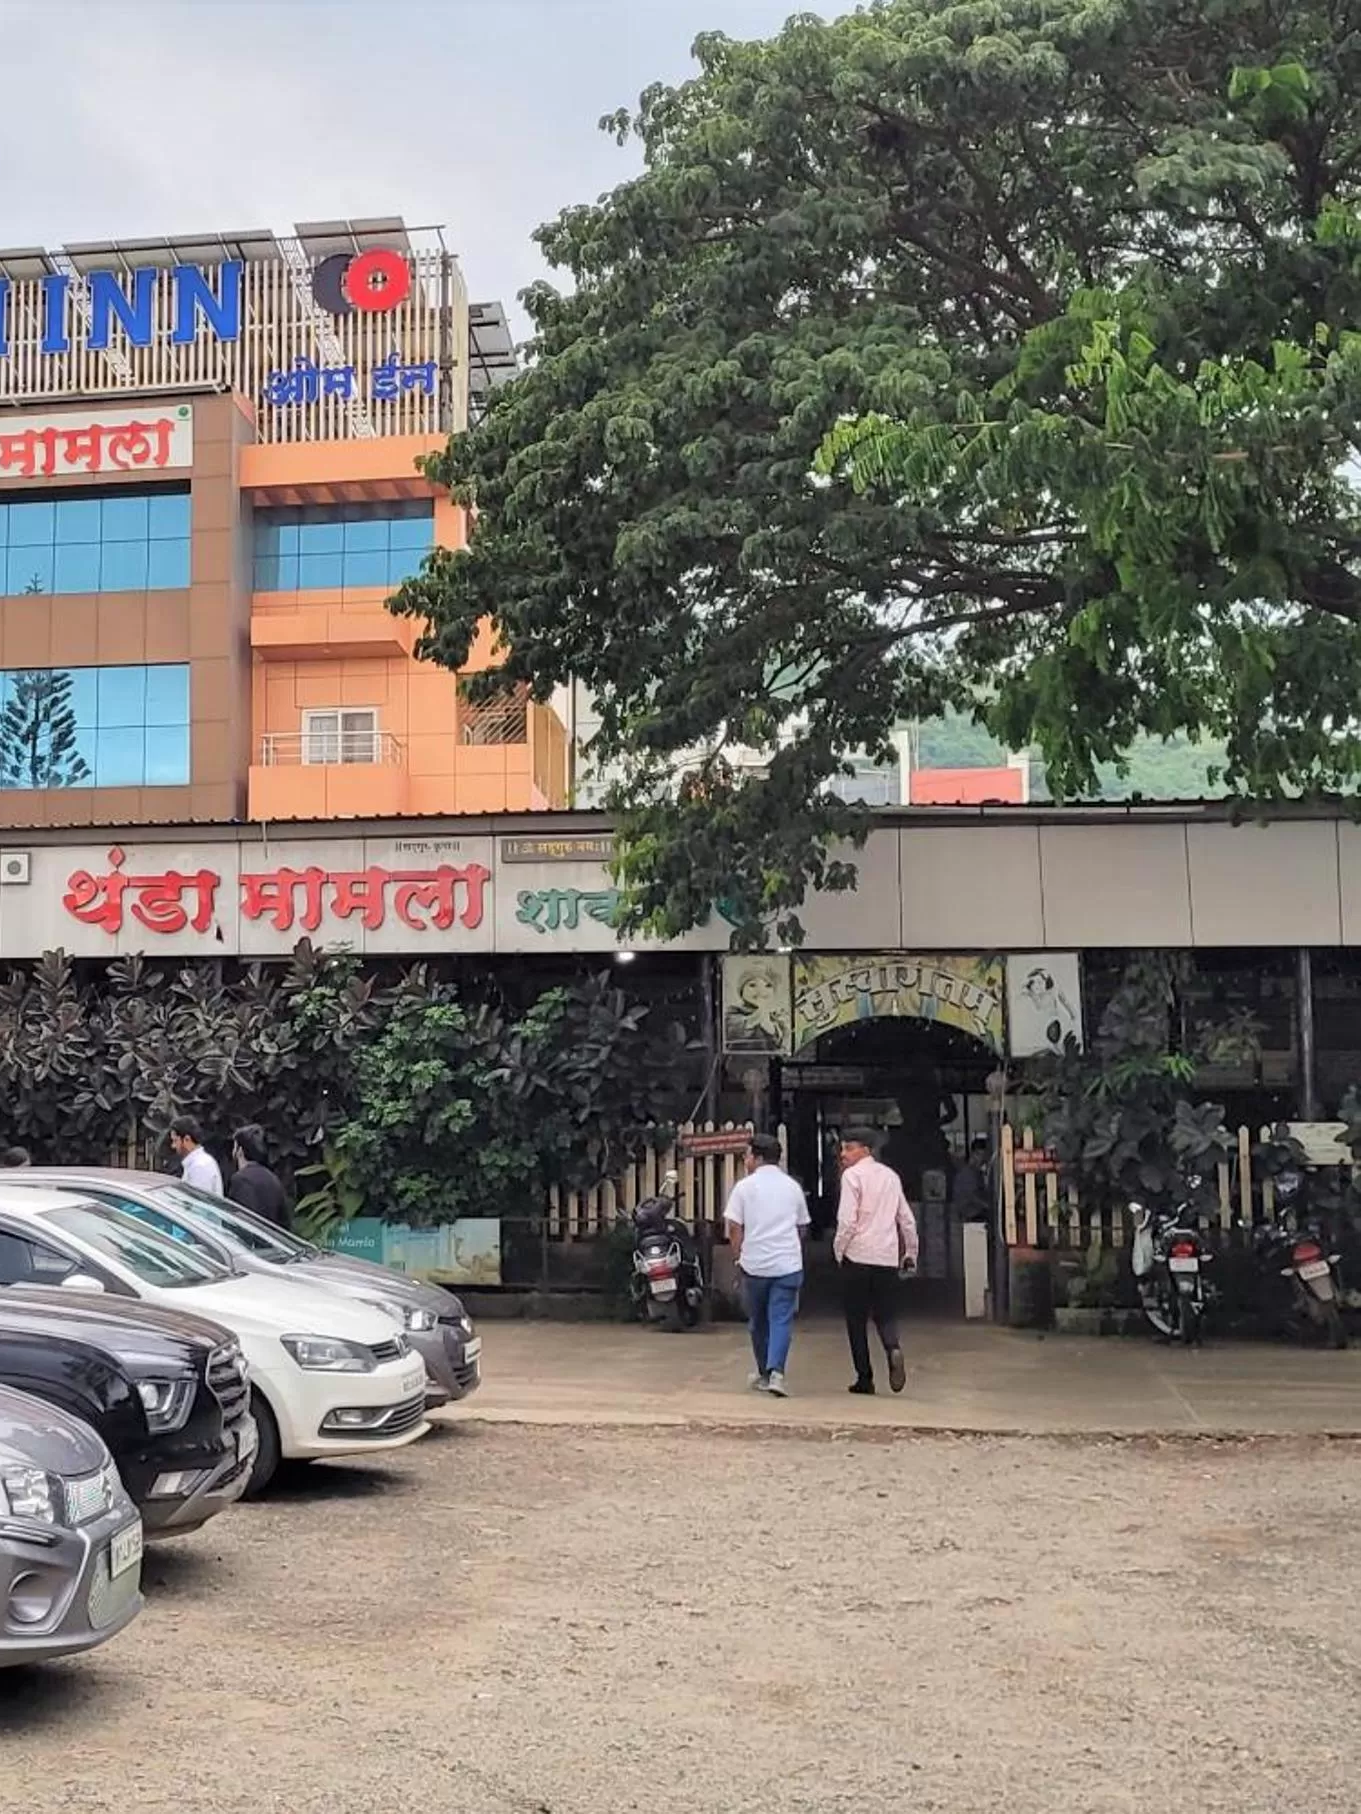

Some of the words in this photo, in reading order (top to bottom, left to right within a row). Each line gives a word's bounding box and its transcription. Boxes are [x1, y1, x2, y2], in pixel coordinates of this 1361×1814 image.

[41, 261, 244, 355] INN
[264, 356, 356, 405] ओम
[371, 351, 438, 402] ईन
[61, 843, 221, 935] थंडा
[240, 863, 492, 931] मामला
